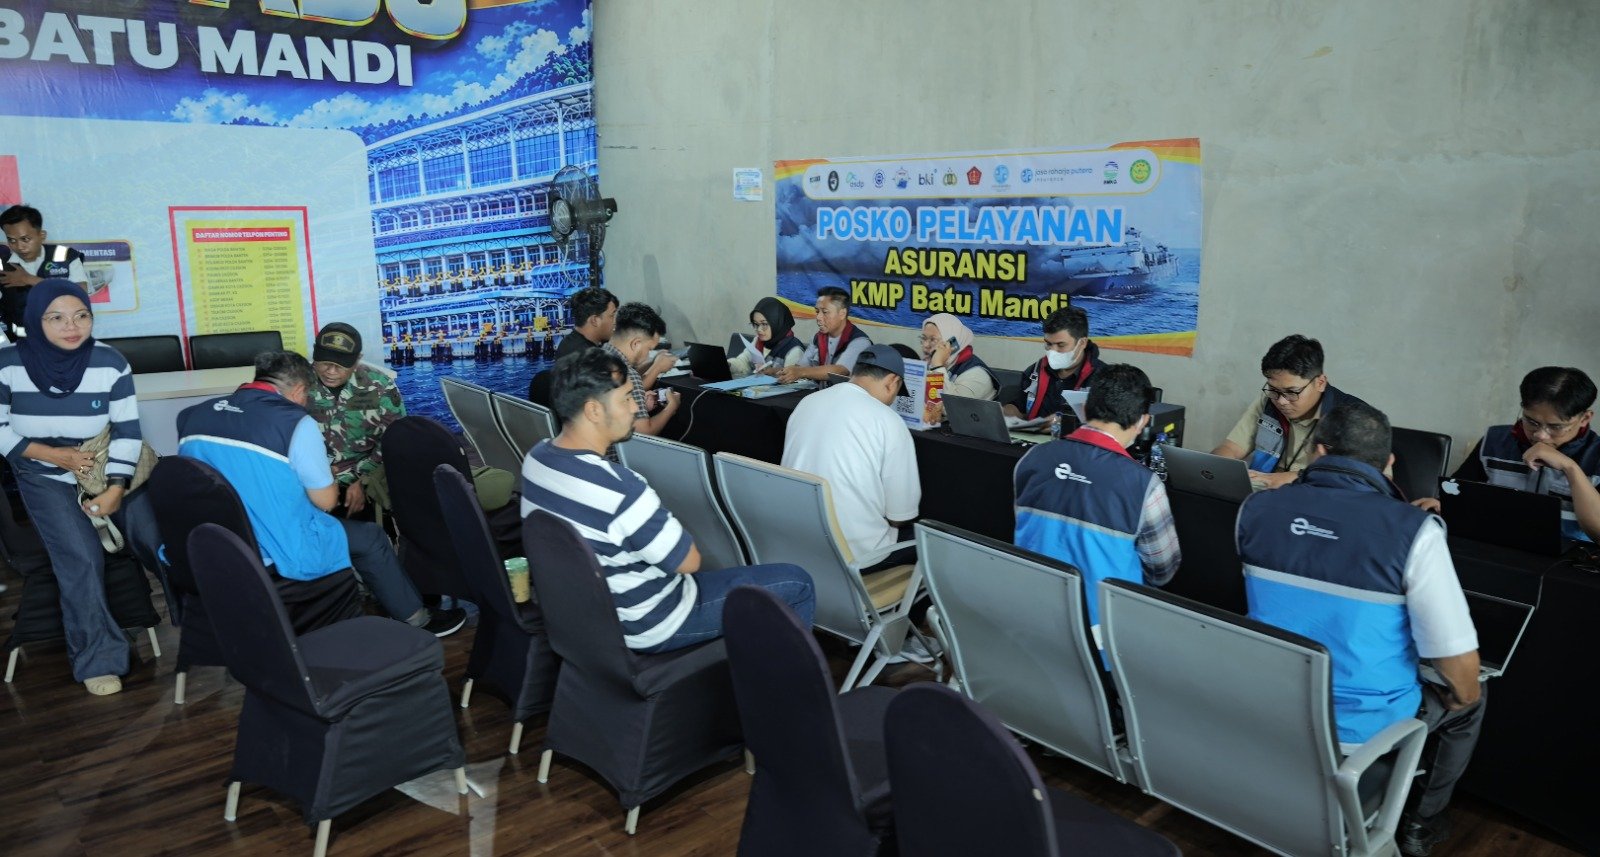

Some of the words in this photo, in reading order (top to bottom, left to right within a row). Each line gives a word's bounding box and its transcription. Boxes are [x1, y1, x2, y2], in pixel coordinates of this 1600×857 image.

[0, 8, 179, 70] BATU
[197, 26, 414, 87] MANDI
[816, 208, 912, 241] POSKO
[918, 207, 1124, 243] PELAYANAN
[884, 249, 1027, 282] ASURANSI
[850, 280, 904, 308] KMP
[911, 284, 972, 314] Batu
